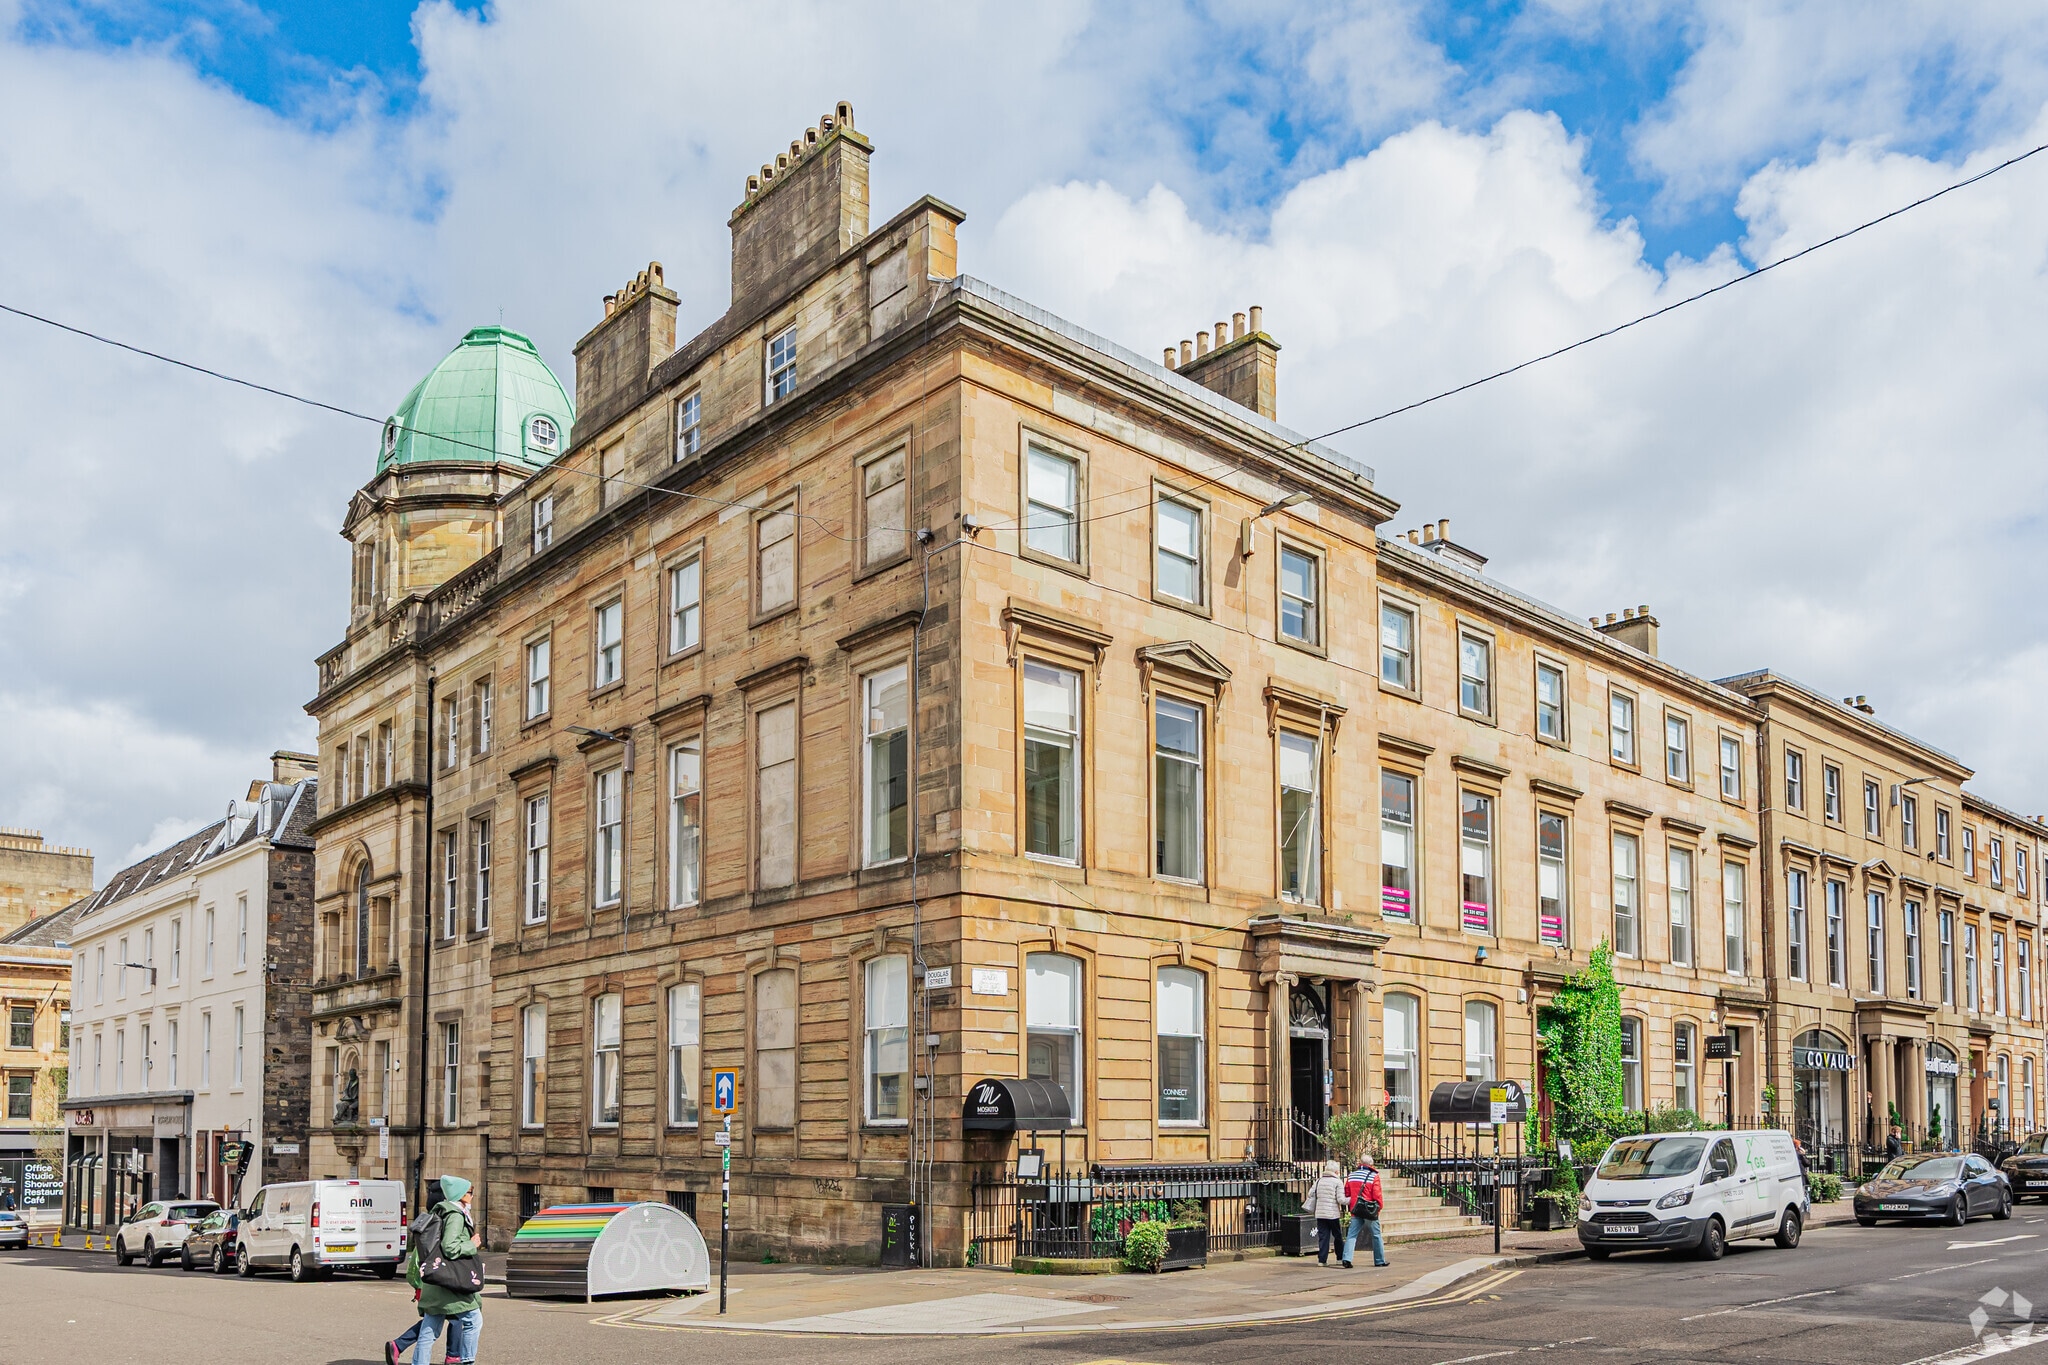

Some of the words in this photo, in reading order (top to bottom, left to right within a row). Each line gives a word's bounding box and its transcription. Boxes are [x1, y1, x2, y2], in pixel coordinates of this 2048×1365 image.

[927, 970, 949, 978] DOUGLAS
[930, 977, 947, 986] STREET
[1807, 1051, 1857, 1070] COVAULT
[1163, 1088, 1188, 1096] CONNECT
[25, 1164, 53, 1172] Office
[25, 1172, 54, 1180] Studio
[25, 1180, 64, 1188] Showroo
[25, 1188, 64, 1196] Restaura
[24, 1196, 46, 1204] Café
[350, 1198, 373, 1208] AIM
